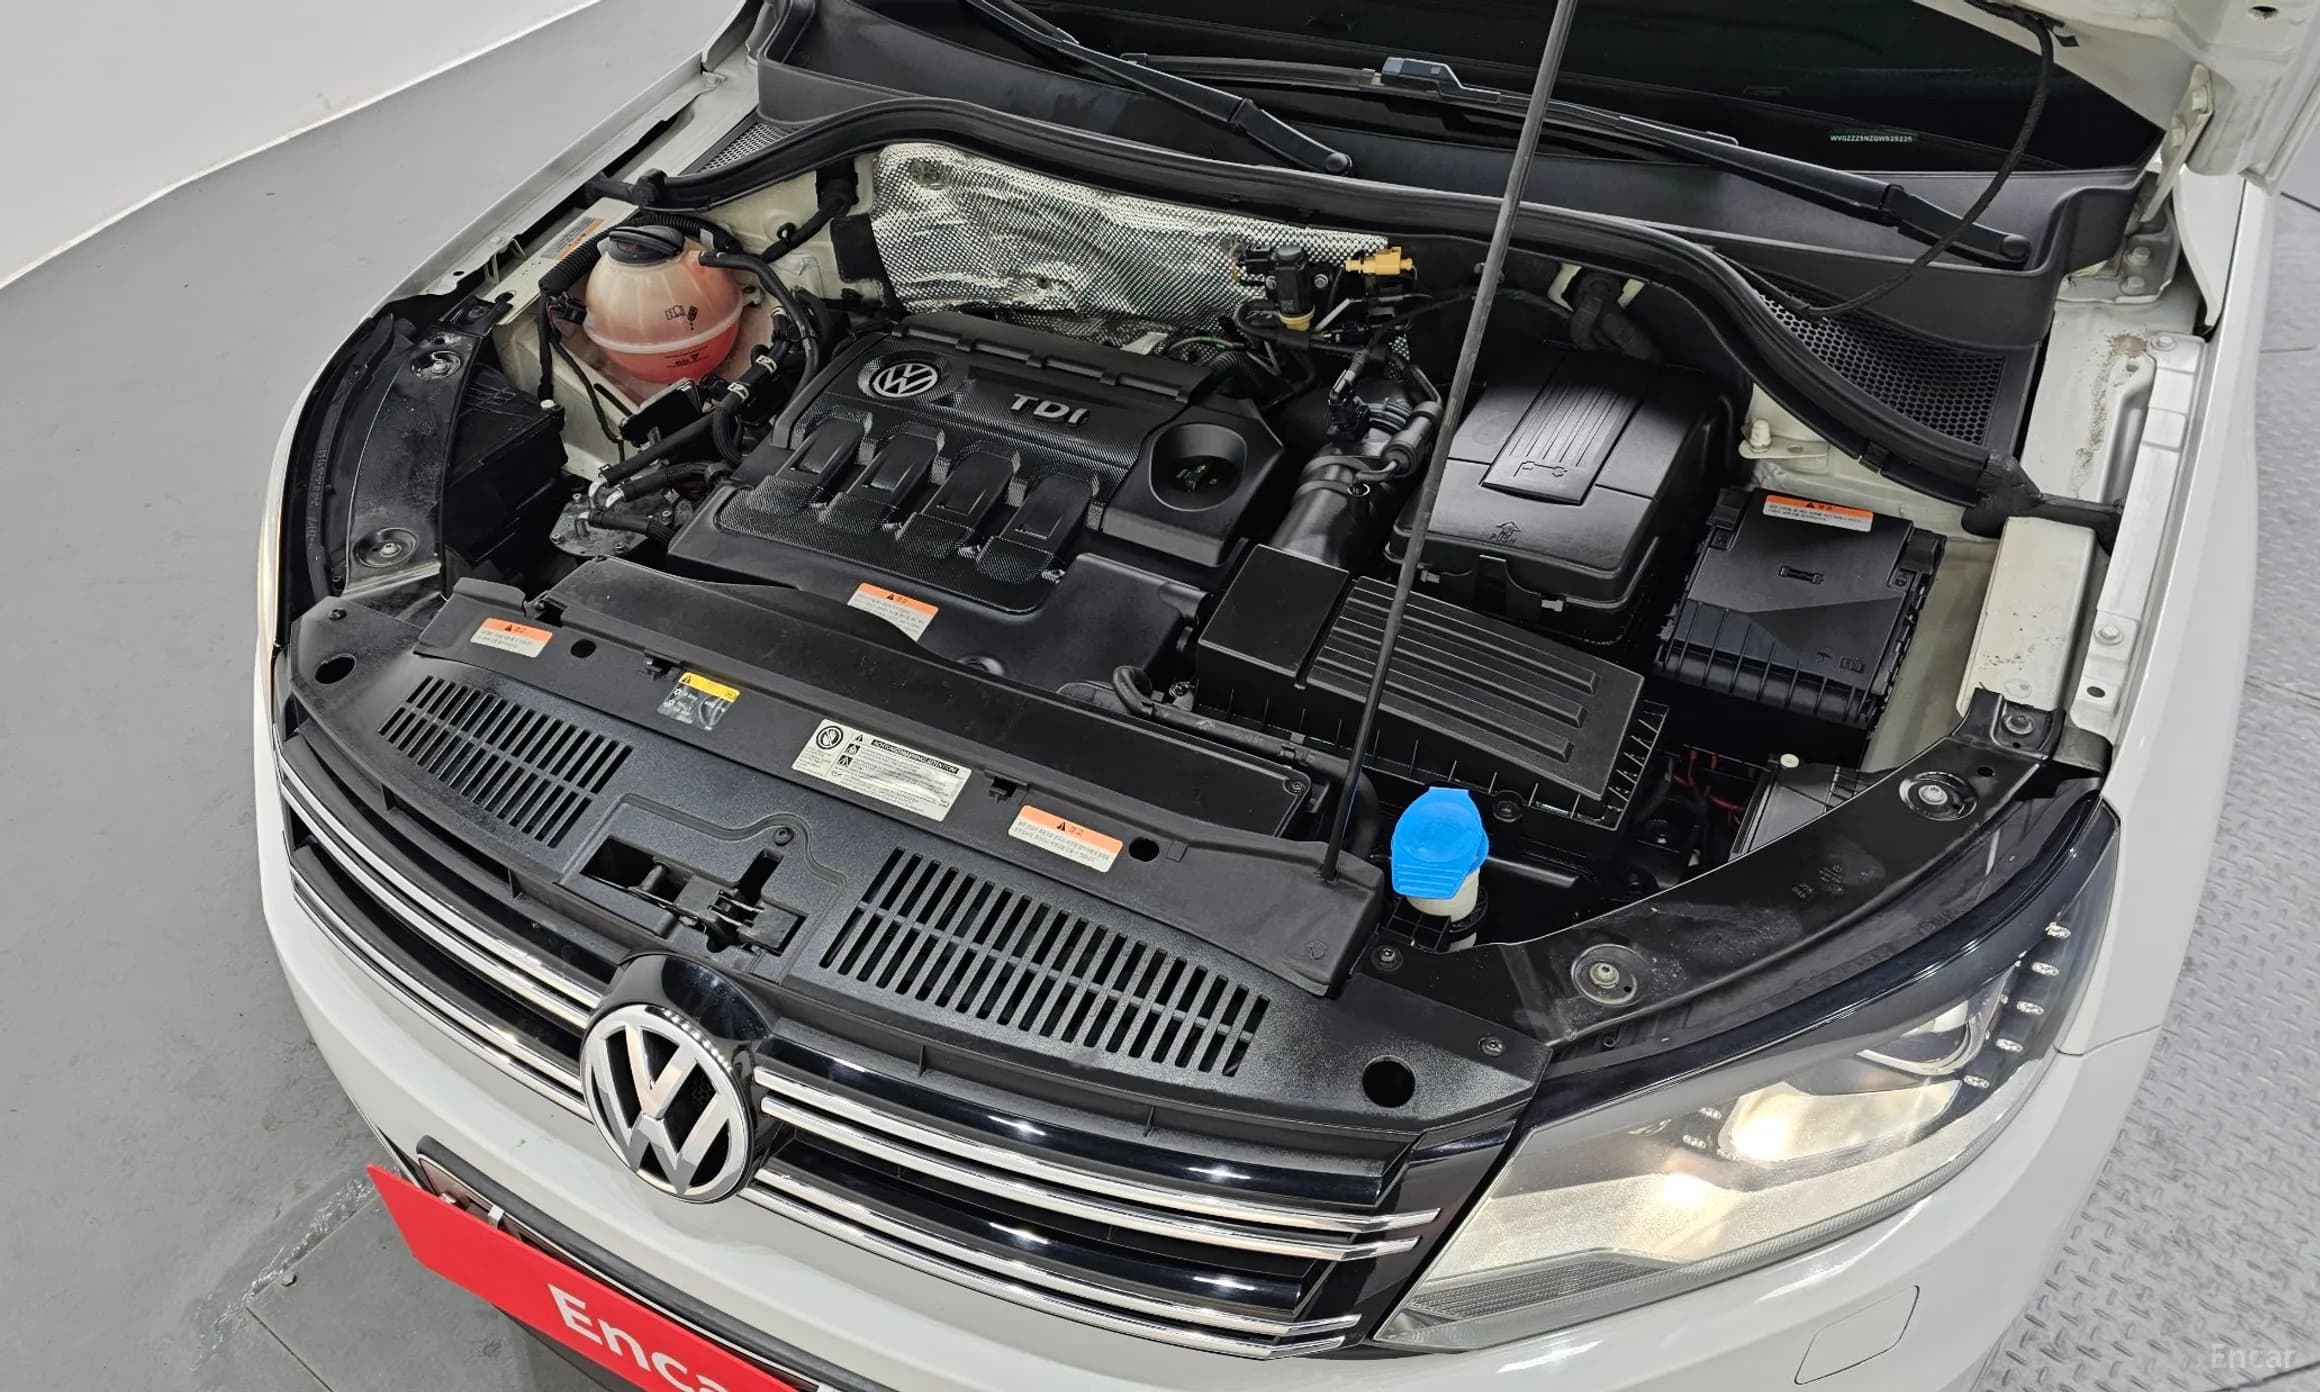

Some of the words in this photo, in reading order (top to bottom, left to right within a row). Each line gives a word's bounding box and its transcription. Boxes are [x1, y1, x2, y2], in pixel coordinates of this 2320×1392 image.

[872, 363, 939, 398] VW
[1010, 393, 1089, 424] TDI
[1489, 533, 1517, 544] PUSH
[582, 1008, 745, 1202] VW
